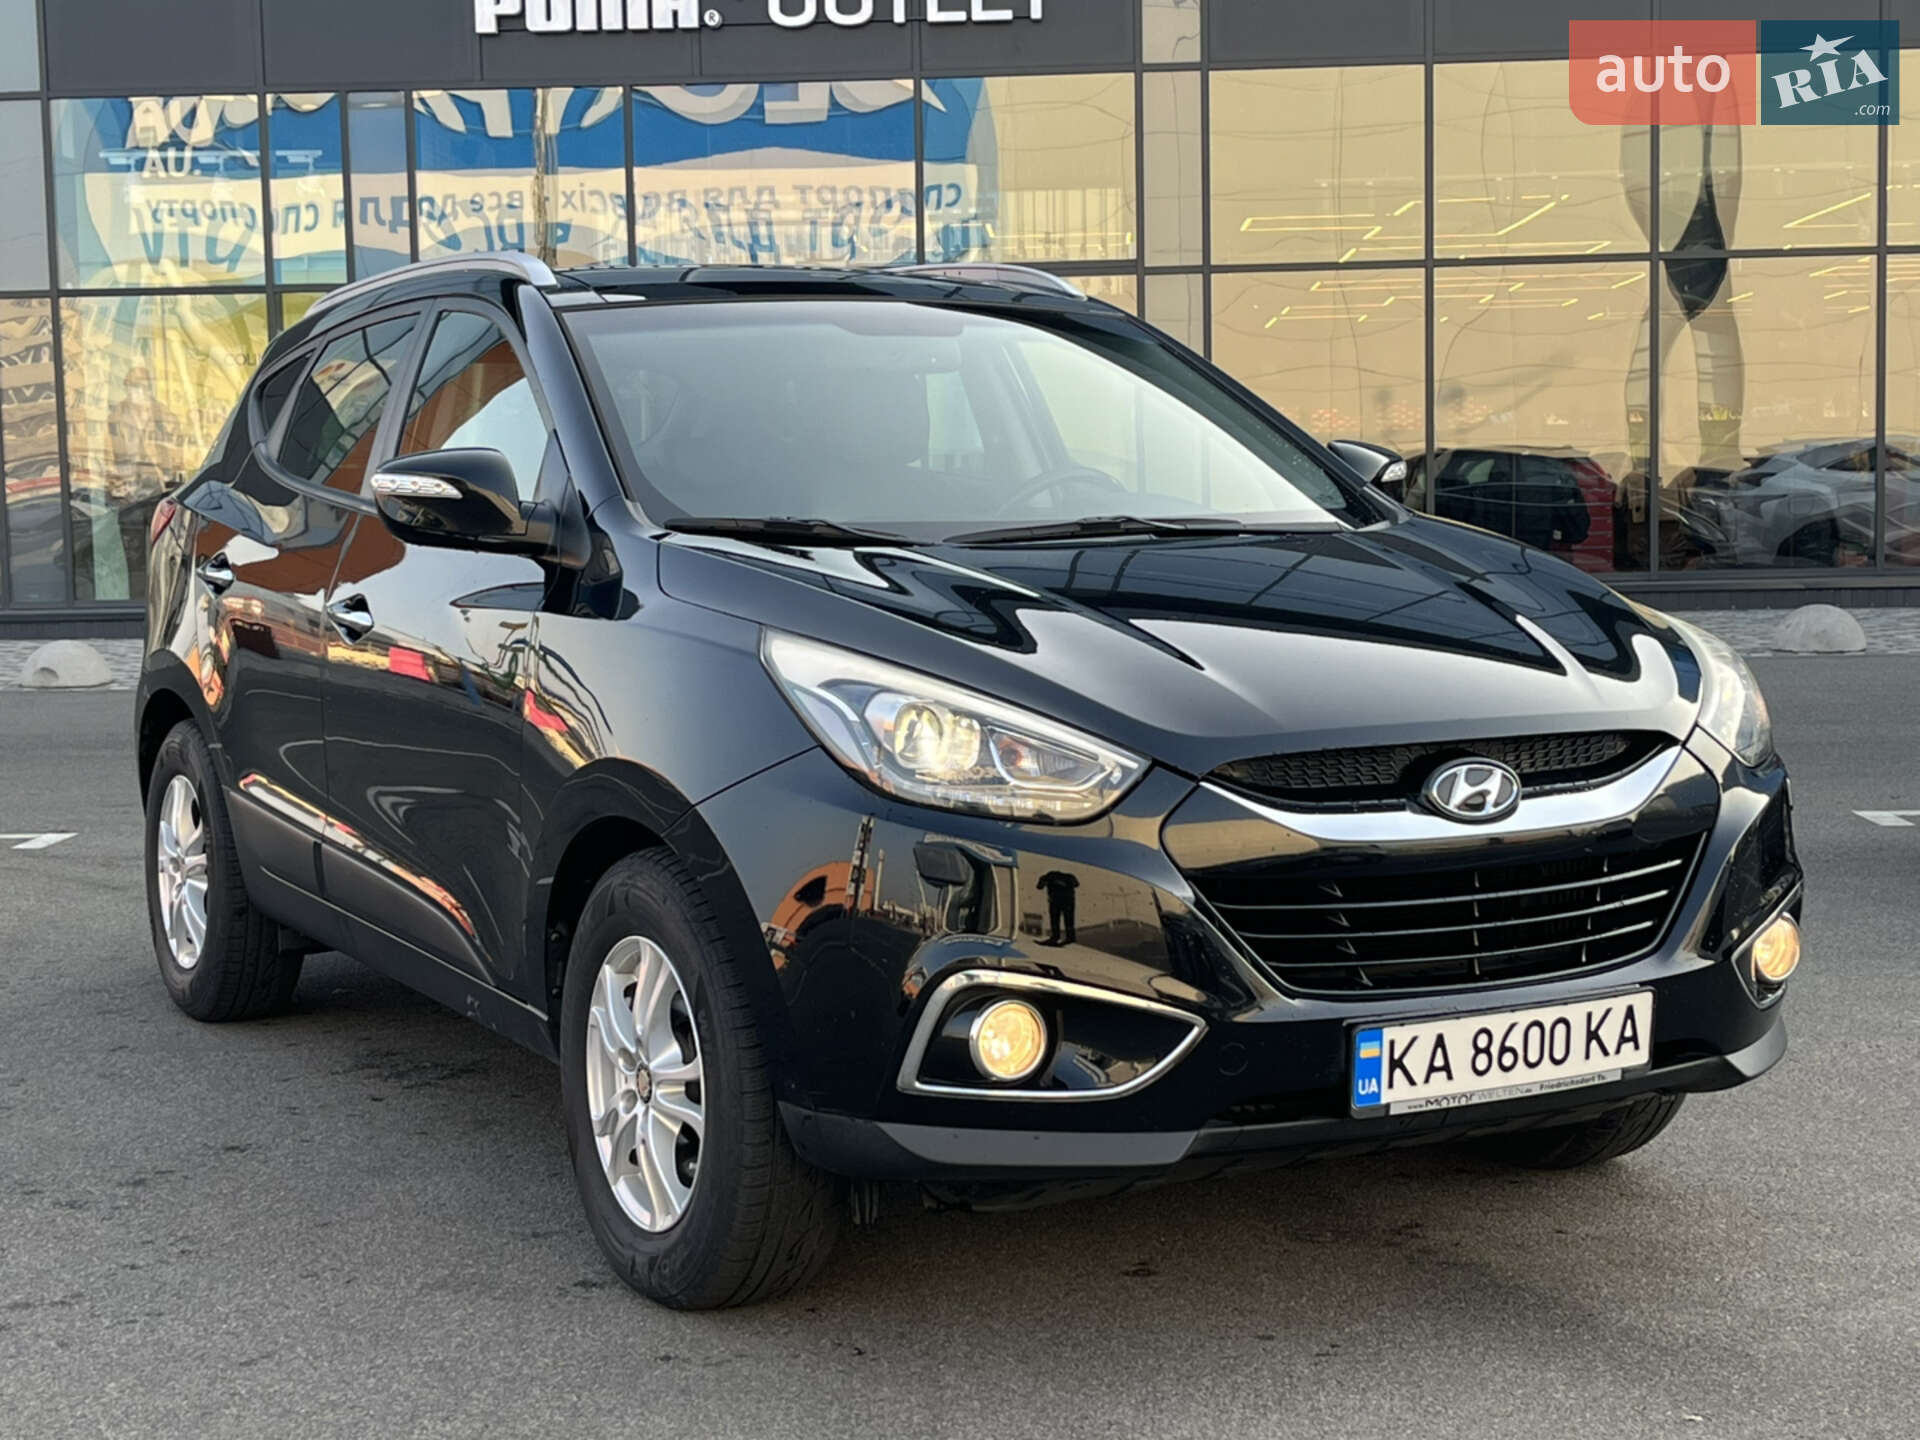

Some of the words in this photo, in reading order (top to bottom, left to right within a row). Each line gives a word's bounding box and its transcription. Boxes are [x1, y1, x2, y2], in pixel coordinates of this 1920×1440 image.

[768, 0, 1043, 27] OUL
[1387, 1032, 1454, 1089] KA
[1470, 1016, 1571, 1077] 8600
[1584, 1004, 1641, 1061] KA
[1358, 1077, 1379, 1096] UA
